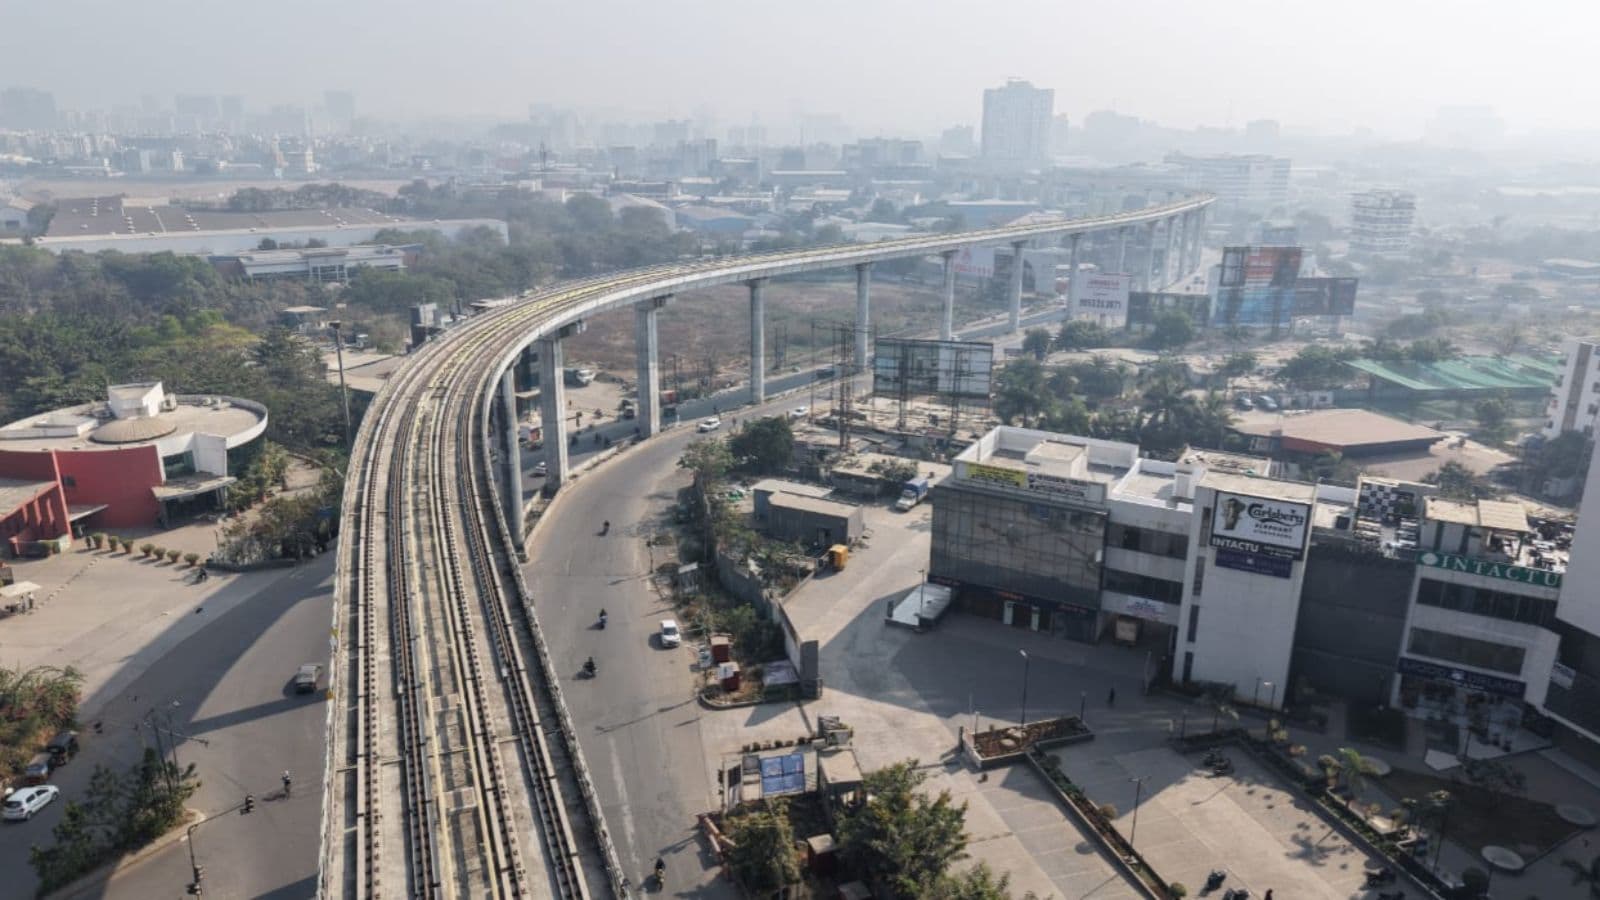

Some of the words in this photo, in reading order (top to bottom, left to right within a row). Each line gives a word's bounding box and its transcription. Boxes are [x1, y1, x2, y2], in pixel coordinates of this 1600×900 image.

[1248, 503, 1304, 526] Carlsberg
[1212, 537, 1259, 553] INTACTU
[1441, 555, 1558, 586] INTACTU
